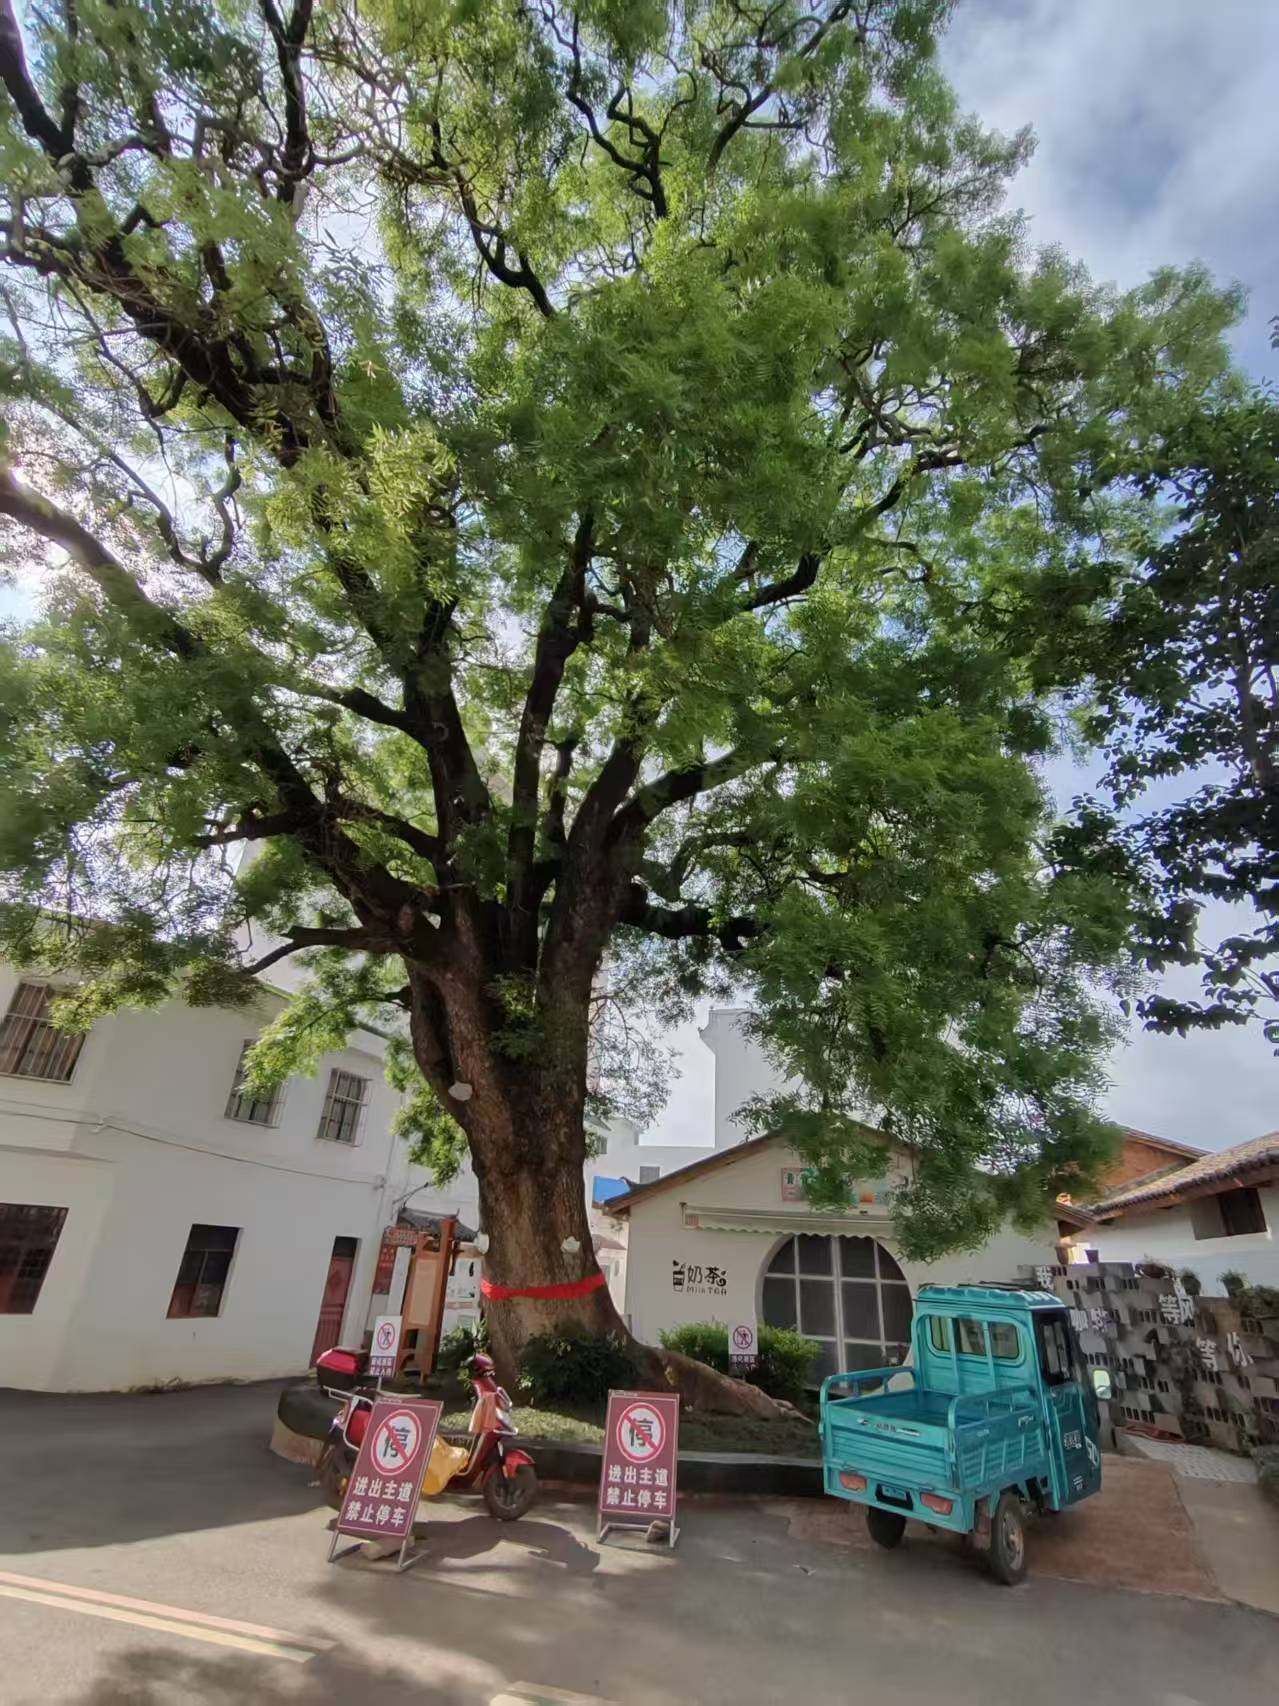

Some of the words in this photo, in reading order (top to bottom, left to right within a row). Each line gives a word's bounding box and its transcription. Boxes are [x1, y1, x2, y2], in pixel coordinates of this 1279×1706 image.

[687, 1264, 722, 1285] 奶茶
[608, 1464, 668, 1487] 进出主道
[353, 1476, 413, 1501] 进出主道
[606, 1487, 667, 1510] 禁止停车
[346, 1502, 406, 1527] 禁止停车
